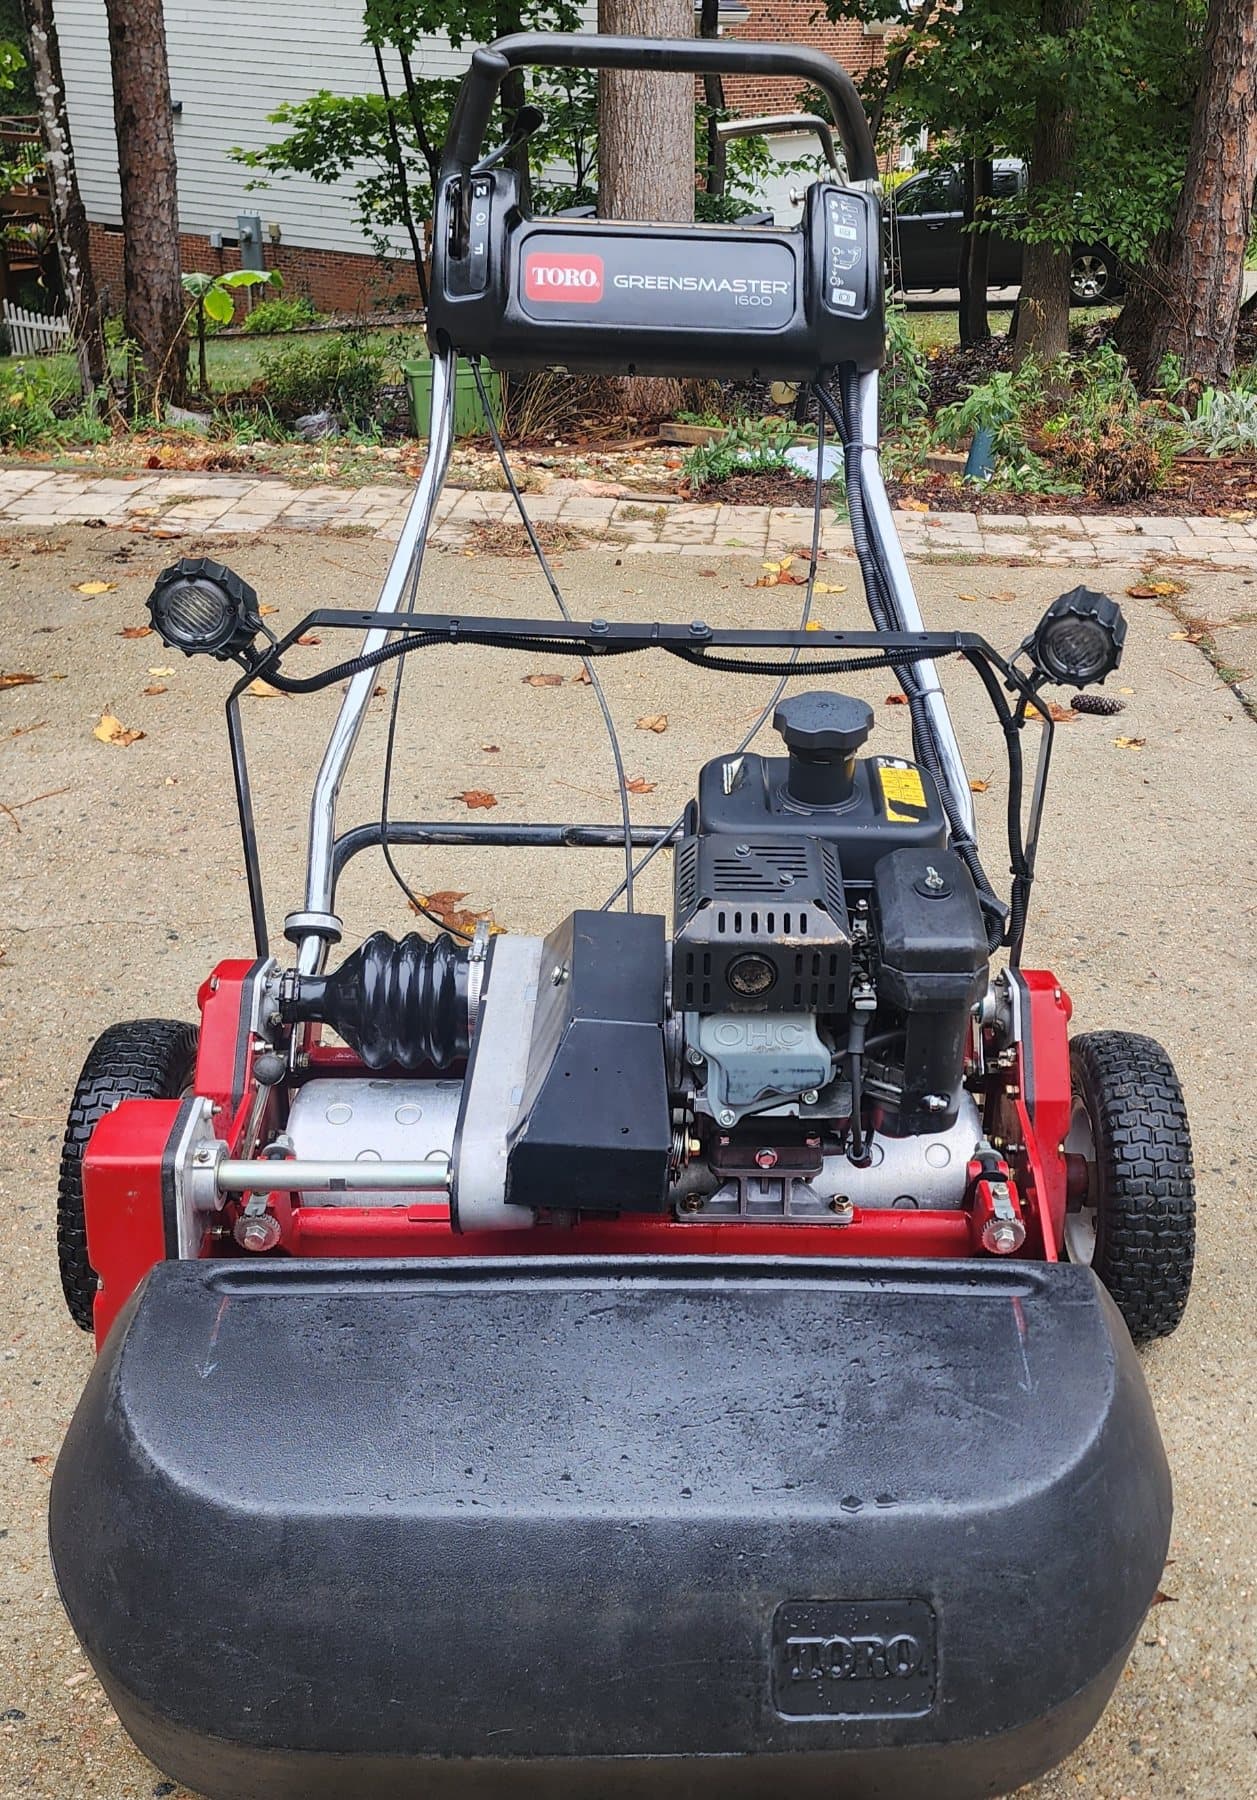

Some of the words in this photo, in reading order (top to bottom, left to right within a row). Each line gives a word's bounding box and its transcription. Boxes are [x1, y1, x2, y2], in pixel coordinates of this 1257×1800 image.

[531, 267, 598, 288] TORO
[613, 274, 788, 295] GREENSMASTER
[734, 295, 773, 306] 1600
[714, 1022, 804, 1048] OHC
[785, 1633, 925, 1681] TORO
